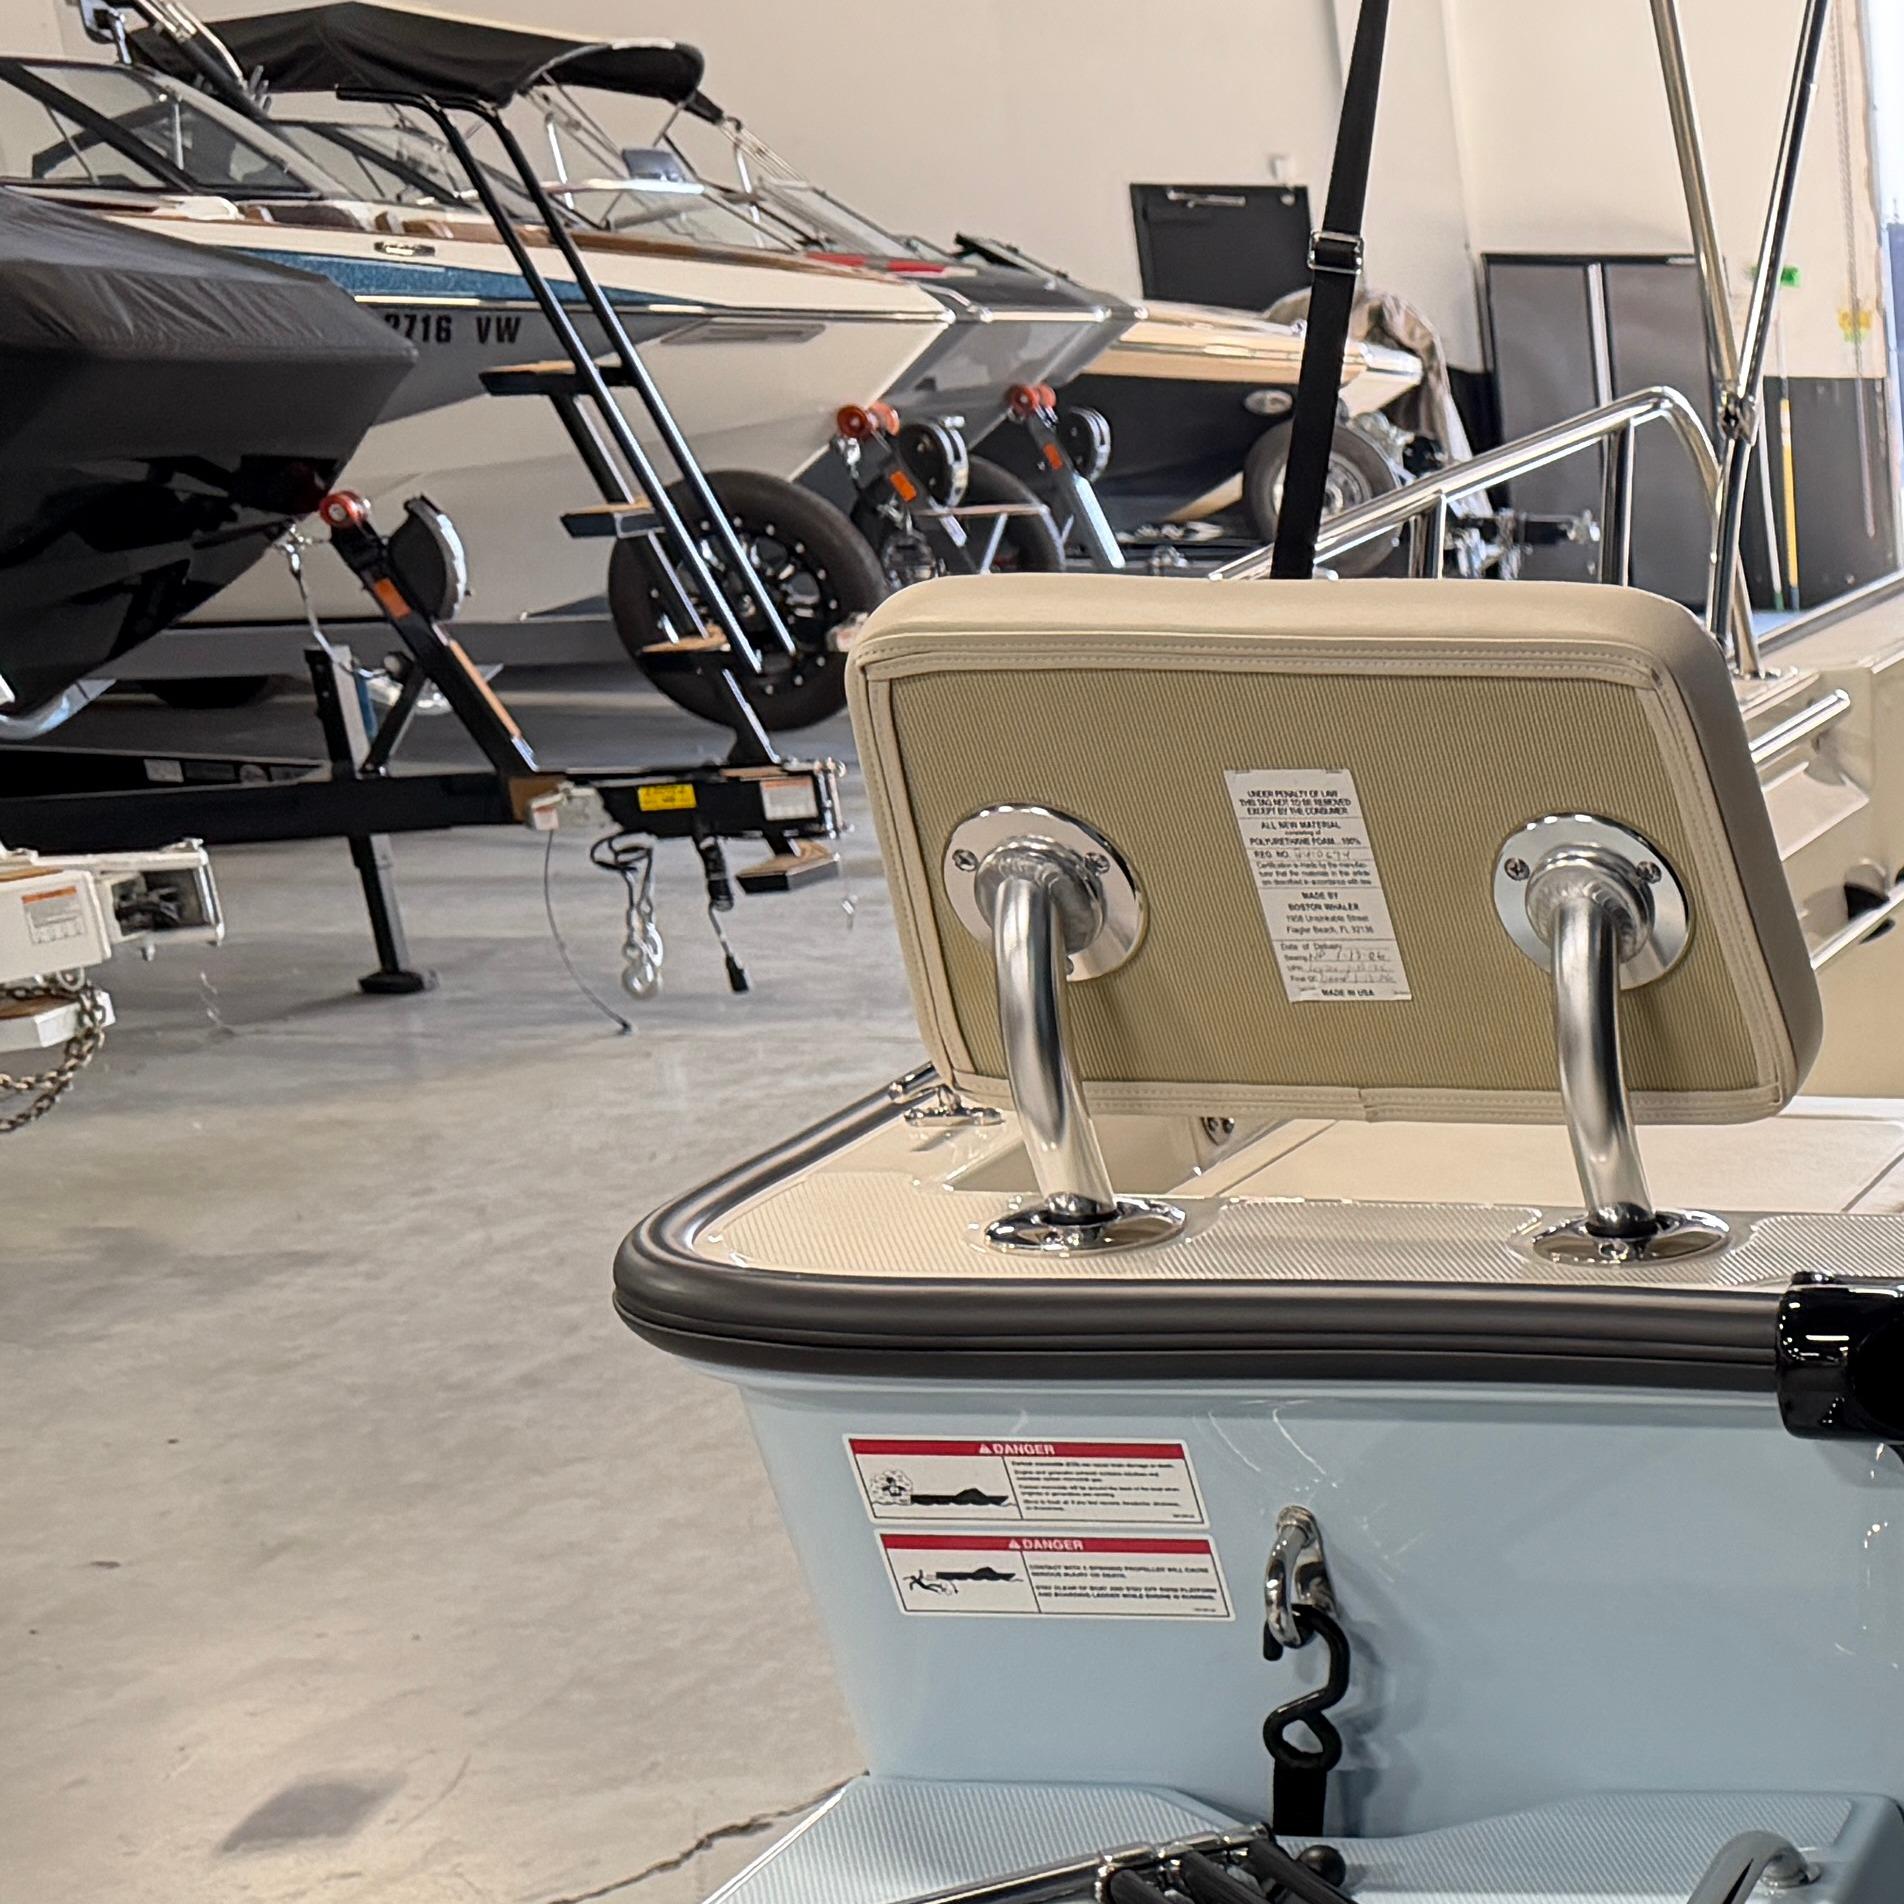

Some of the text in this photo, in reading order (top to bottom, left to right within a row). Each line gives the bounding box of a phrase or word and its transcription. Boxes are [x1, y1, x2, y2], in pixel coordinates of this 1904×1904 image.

[476, 316, 521, 344] VW
[992, 1443, 1056, 1456] DANGER
[1022, 1538, 1085, 1552] DANGER
